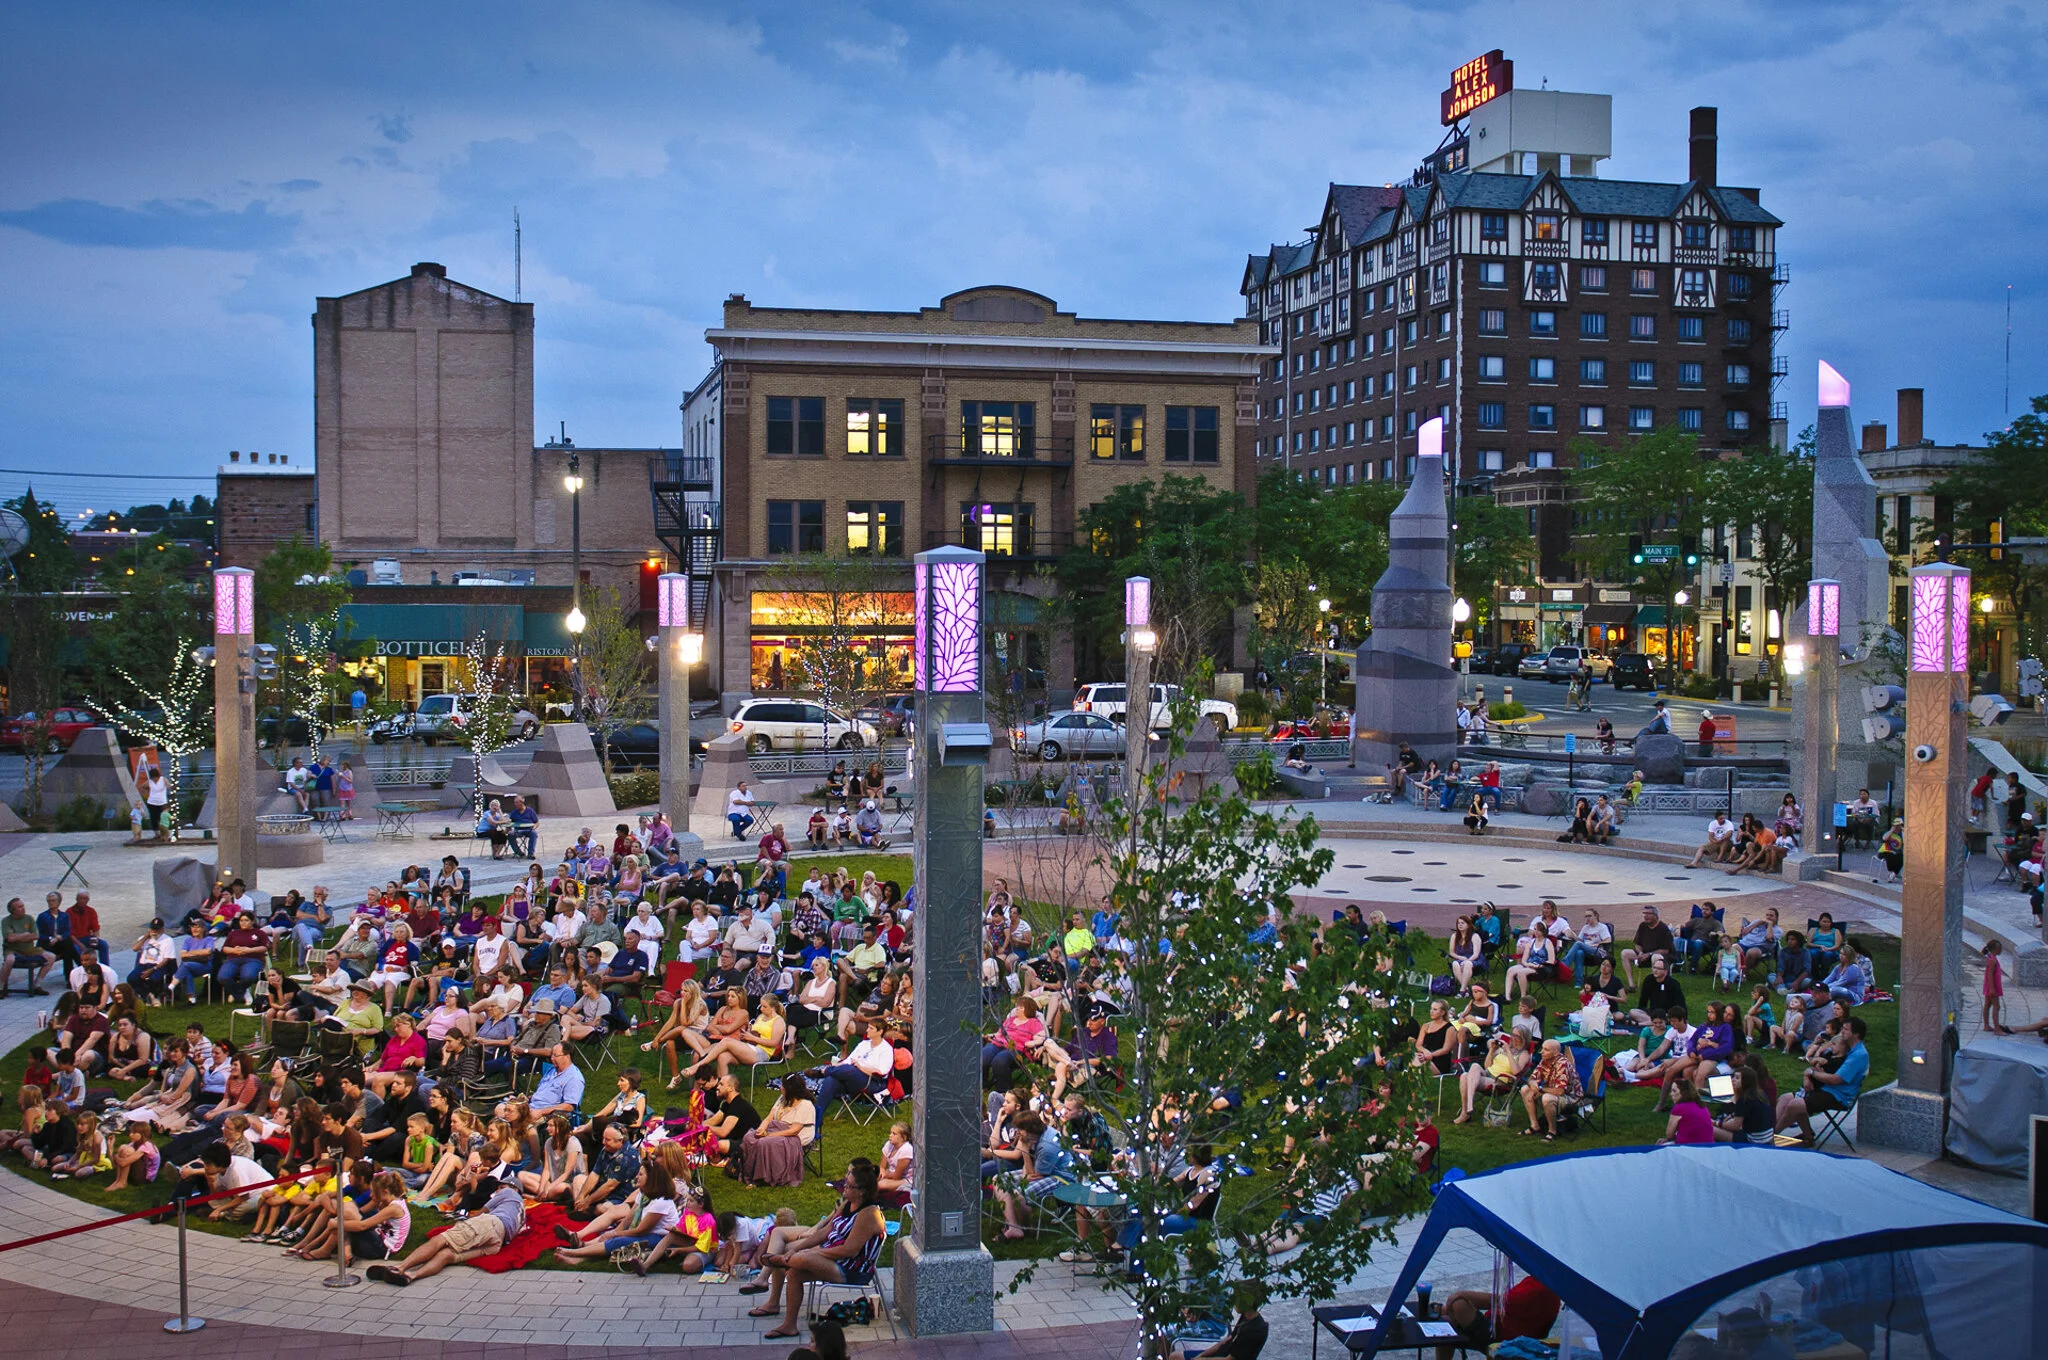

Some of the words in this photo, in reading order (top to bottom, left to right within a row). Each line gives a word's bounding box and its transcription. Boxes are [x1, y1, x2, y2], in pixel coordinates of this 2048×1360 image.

[1454, 55, 1488, 84] HOTEL
[1455, 70, 1488, 100] ALEX
[1447, 83, 1496, 119] JOHNSON
[1645, 547, 1662, 555] MAIN
[1664, 547, 1673, 555] ST
